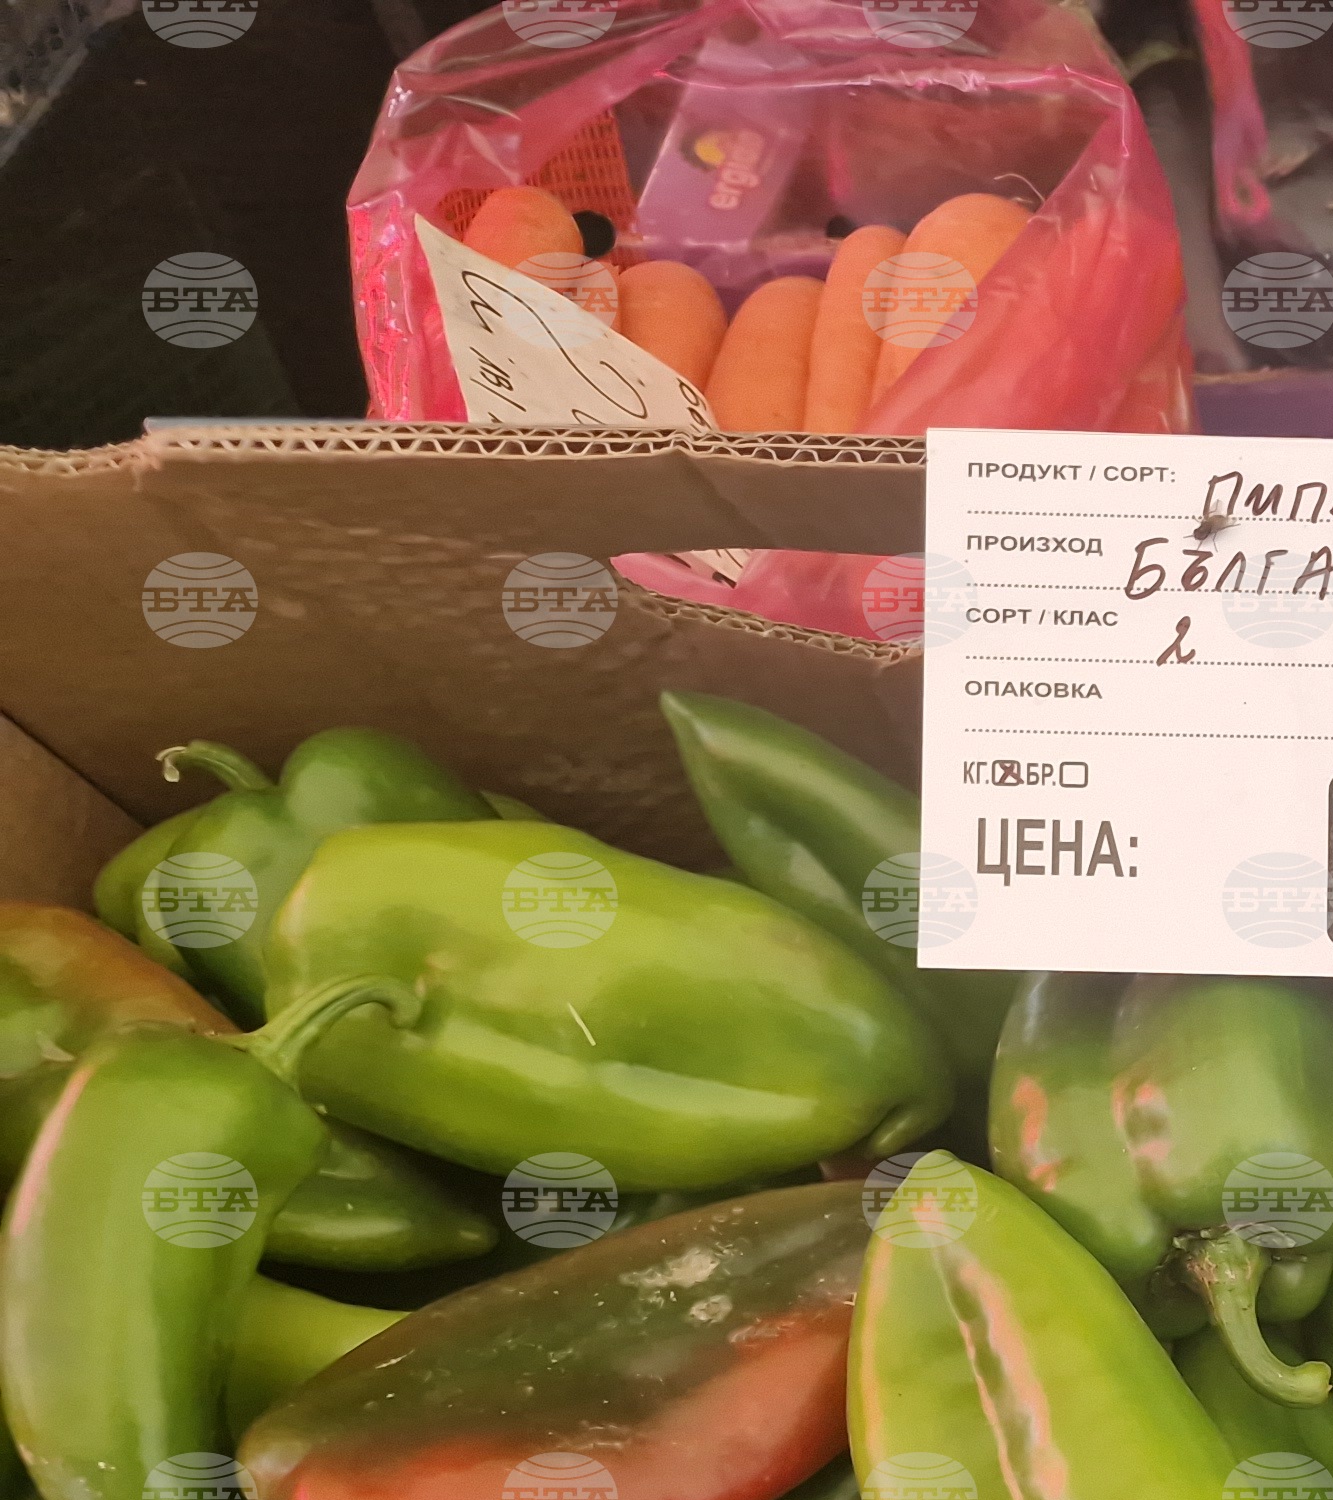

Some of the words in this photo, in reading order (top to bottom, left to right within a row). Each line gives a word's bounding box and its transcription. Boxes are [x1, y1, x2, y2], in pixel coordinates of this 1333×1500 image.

[967, 462, 1082, 481] ПРОДУКТ
[1089, 465, 1096, 481] /
[1103, 466, 1176, 482] СОРТ:
[966, 535, 1103, 556] ПРОИЗХОД
[965, 608, 1033, 626] СОРТ
[1038, 609, 1046, 625] /
[1053, 610, 1119, 627] КЛАС
[1156, 615, 1197, 667] 2
[964, 680, 1103, 699] ОПАКОВКА
[1026, 762, 1057, 786] БР.
[976, 817, 1139, 886] ЦЕНА:
